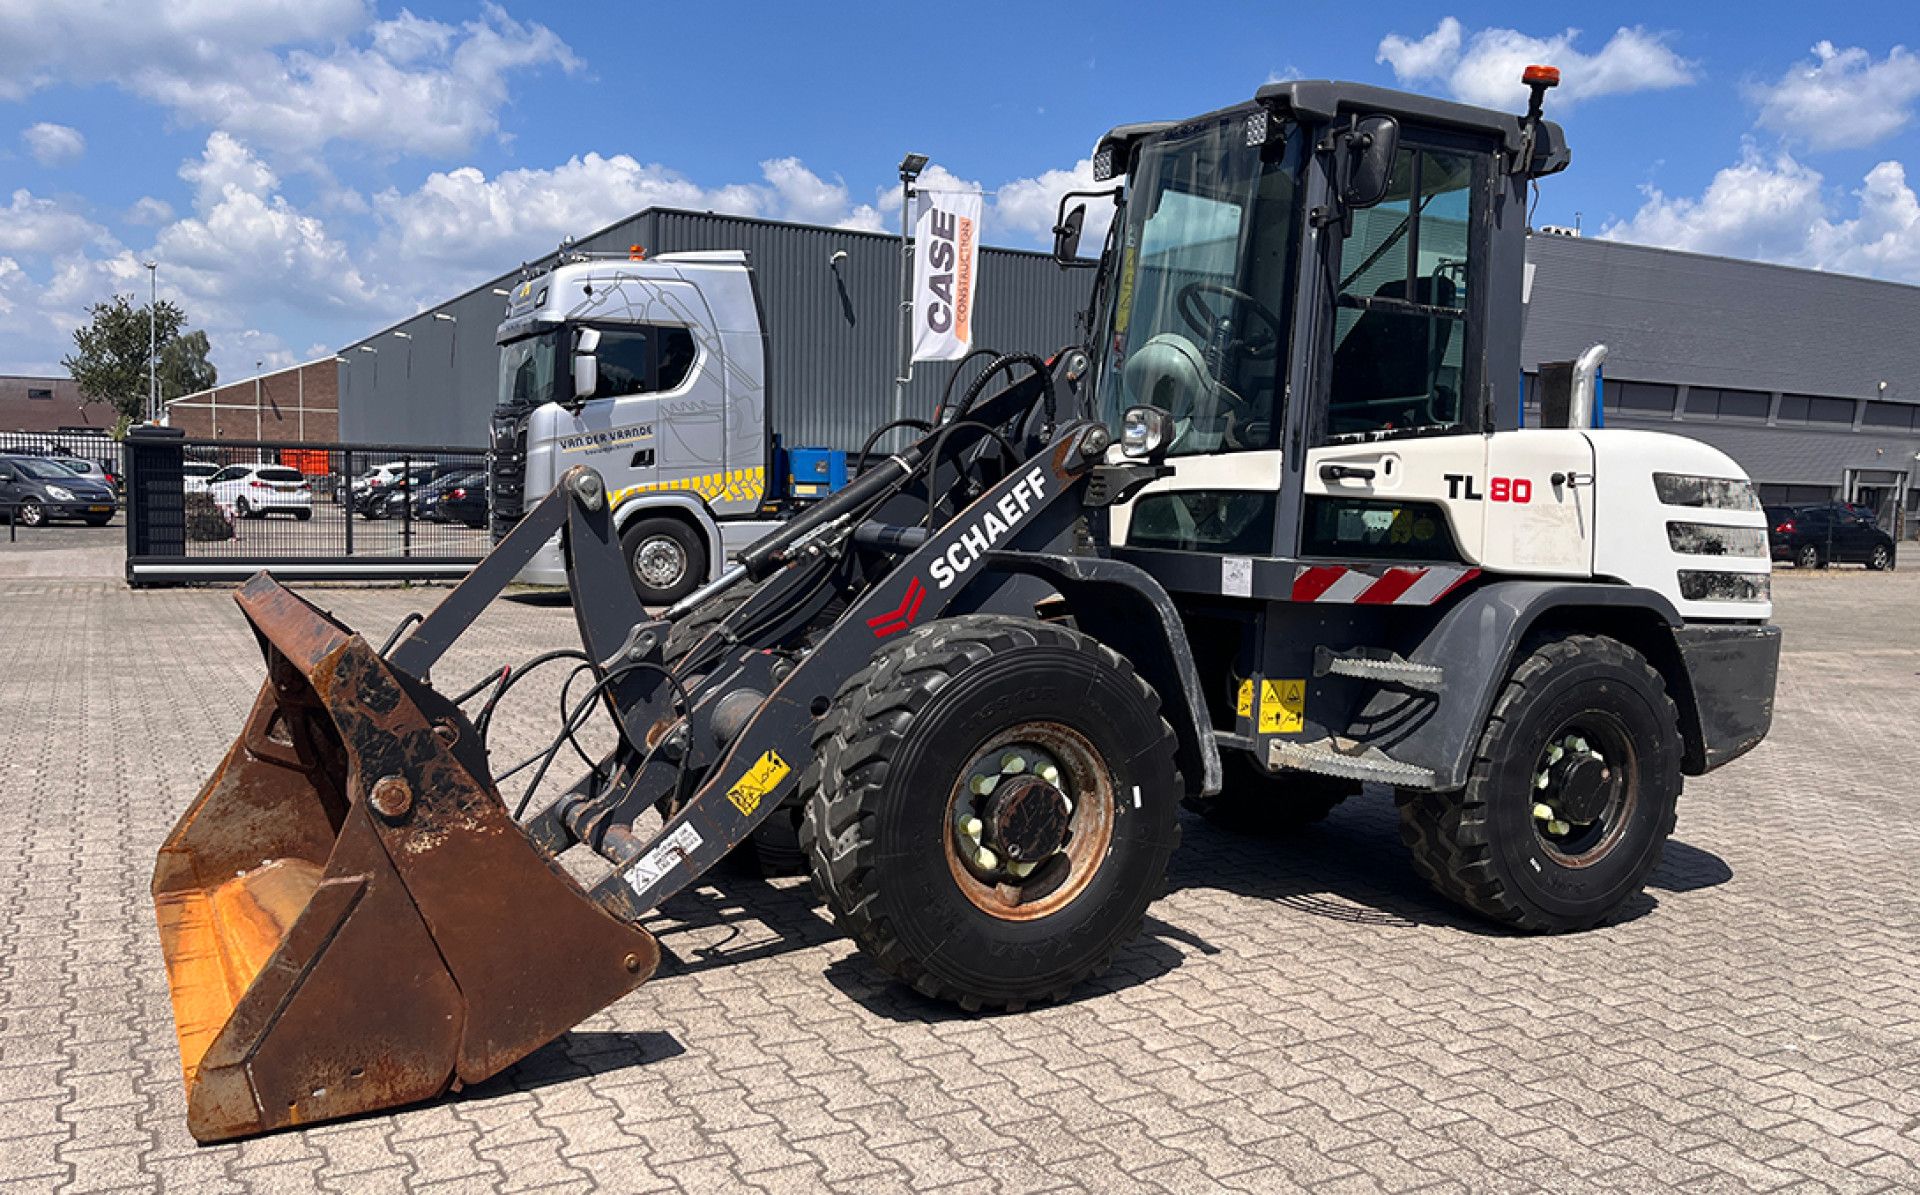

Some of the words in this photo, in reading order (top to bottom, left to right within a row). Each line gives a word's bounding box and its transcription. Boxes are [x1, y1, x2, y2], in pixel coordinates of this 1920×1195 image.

[927, 208, 956, 334] CASE
[956, 219, 971, 324] CONSTRUCTION
[559, 437, 584, 449] VAN
[585, 433, 607, 445] DER
[609, 425, 653, 440] VRANDE
[1444, 474, 1483, 500] TL
[1490, 477, 1532, 504] 80
[930, 466, 1046, 589] SCHAEFF
